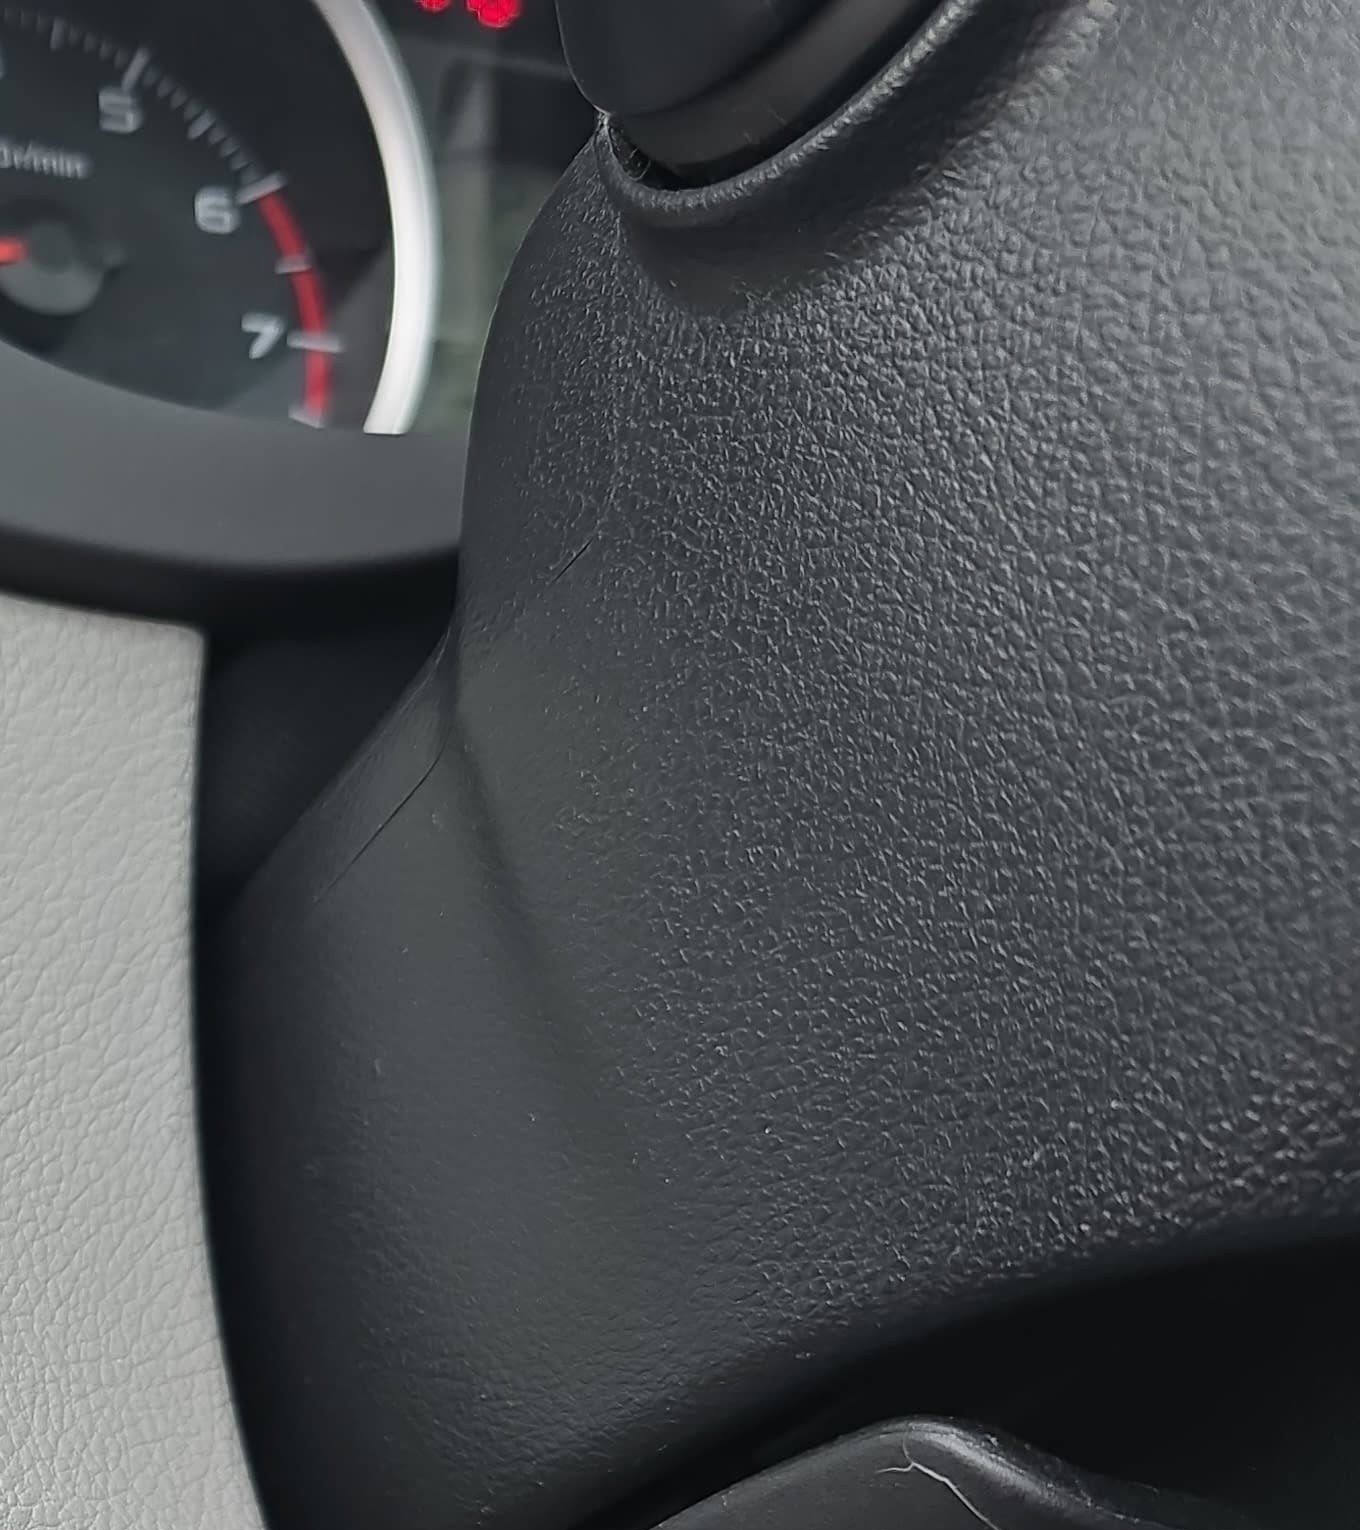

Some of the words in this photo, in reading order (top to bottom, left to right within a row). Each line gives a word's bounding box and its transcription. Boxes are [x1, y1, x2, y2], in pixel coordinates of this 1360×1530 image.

[98, 86, 144, 134] 5
[194, 185, 242, 235] 6
[241, 313, 286, 360] 7
